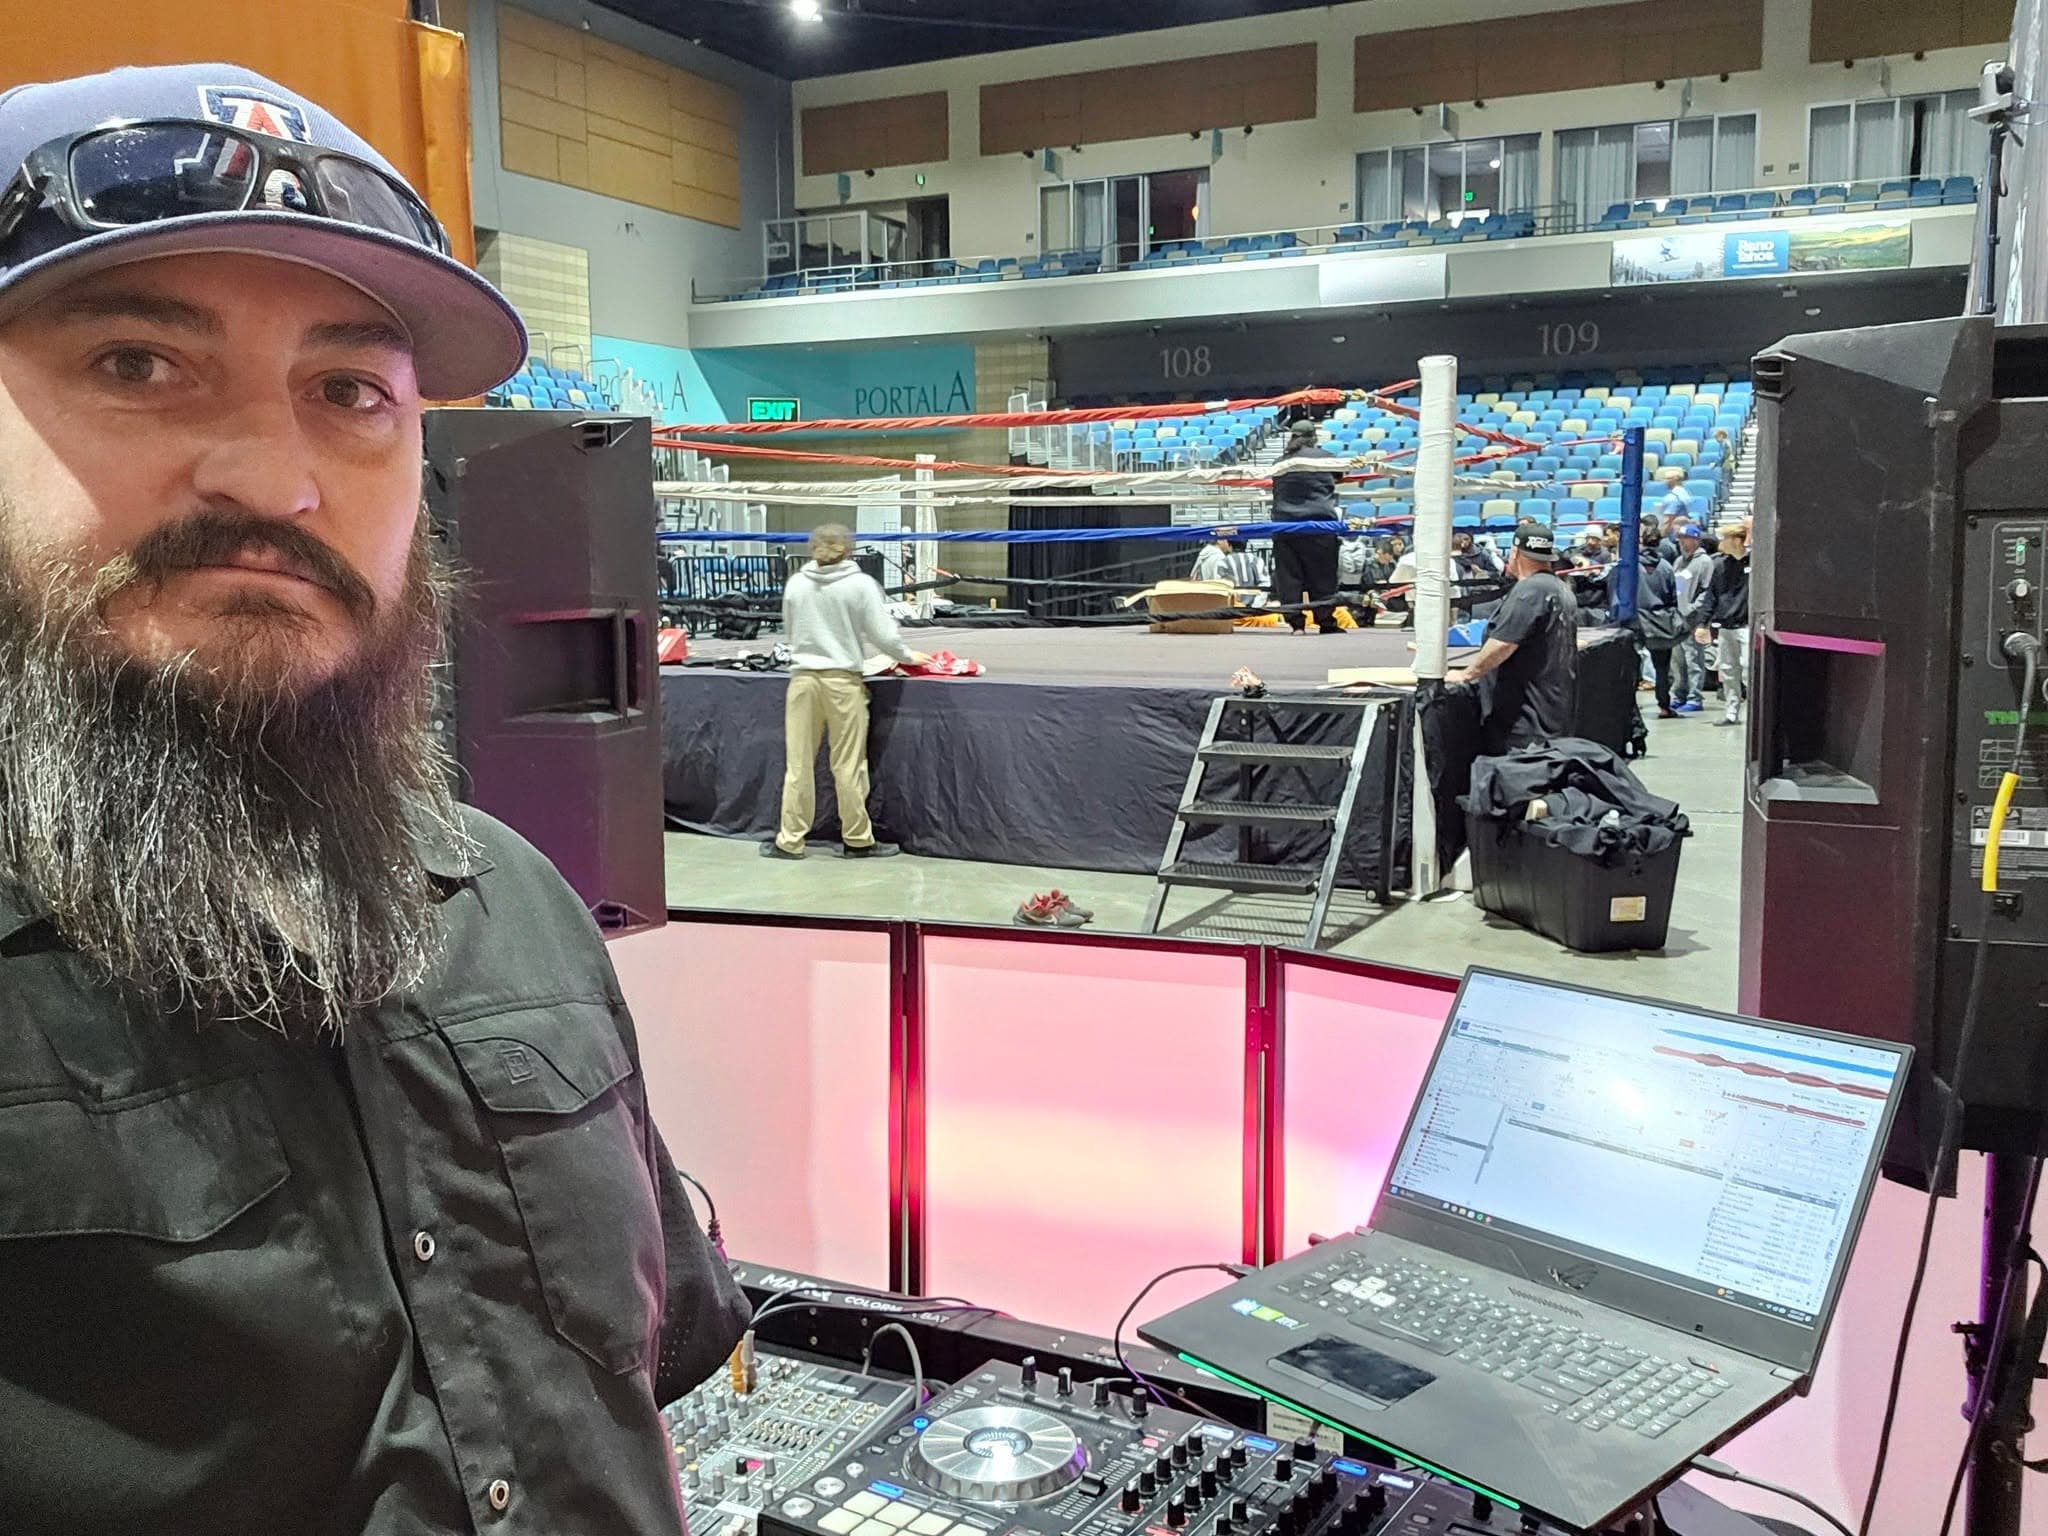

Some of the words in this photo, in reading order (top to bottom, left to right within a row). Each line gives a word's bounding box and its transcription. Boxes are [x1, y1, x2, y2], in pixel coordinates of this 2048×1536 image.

[1537, 321, 1599, 355] 109
[1160, 346, 1211, 378] 108
[751, 401, 796, 421] EXIT
